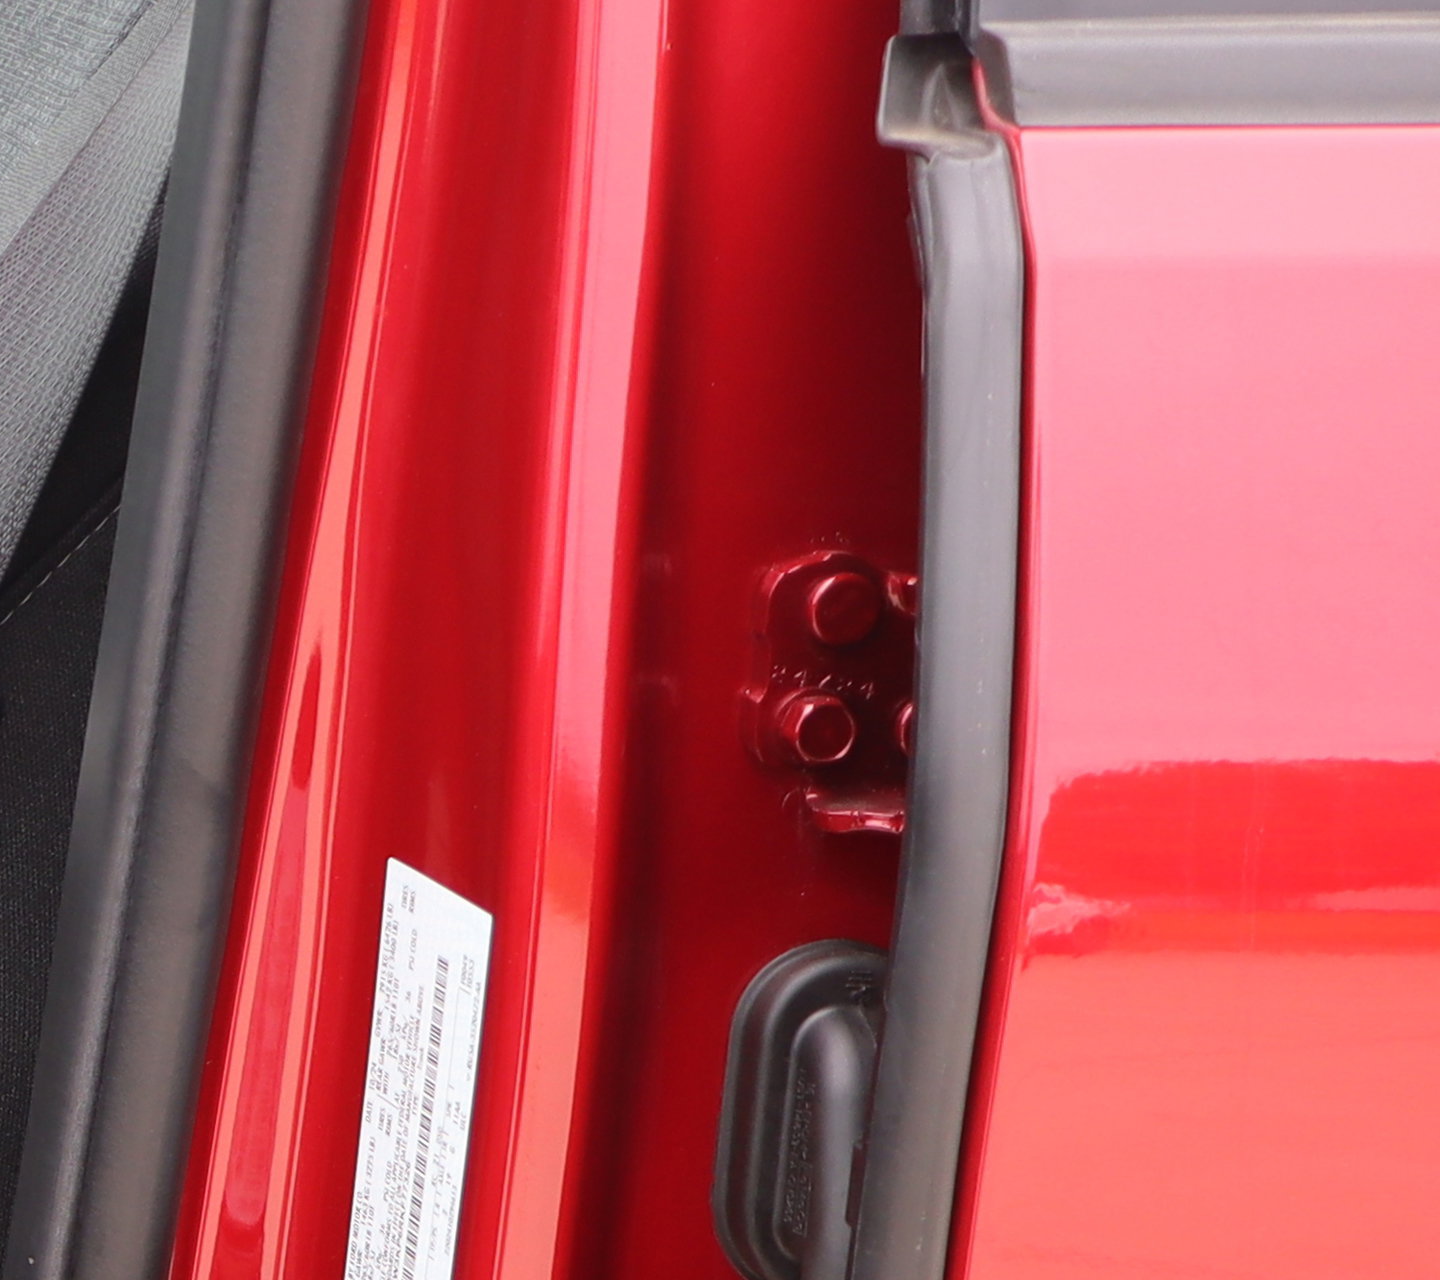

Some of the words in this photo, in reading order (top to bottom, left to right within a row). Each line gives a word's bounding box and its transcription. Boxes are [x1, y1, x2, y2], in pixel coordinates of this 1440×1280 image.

[375, 1065, 383, 1091] REAR
[381, 1070, 389, 1096] WITH
[404, 1054, 416, 1123] MANUFACTURE
[412, 1016, 420, 1053] SHOWN
[382, 1216, 392, 1269] CONFORMS
[391, 1129, 402, 1183] APPLICABLE
[402, 1052, 410, 1087] MOTOR
[406, 1013, 415, 1051] VEHICLE
[352, 1204, 360, 1240] MOTOR
[349, 1239, 357, 1266] FORD
